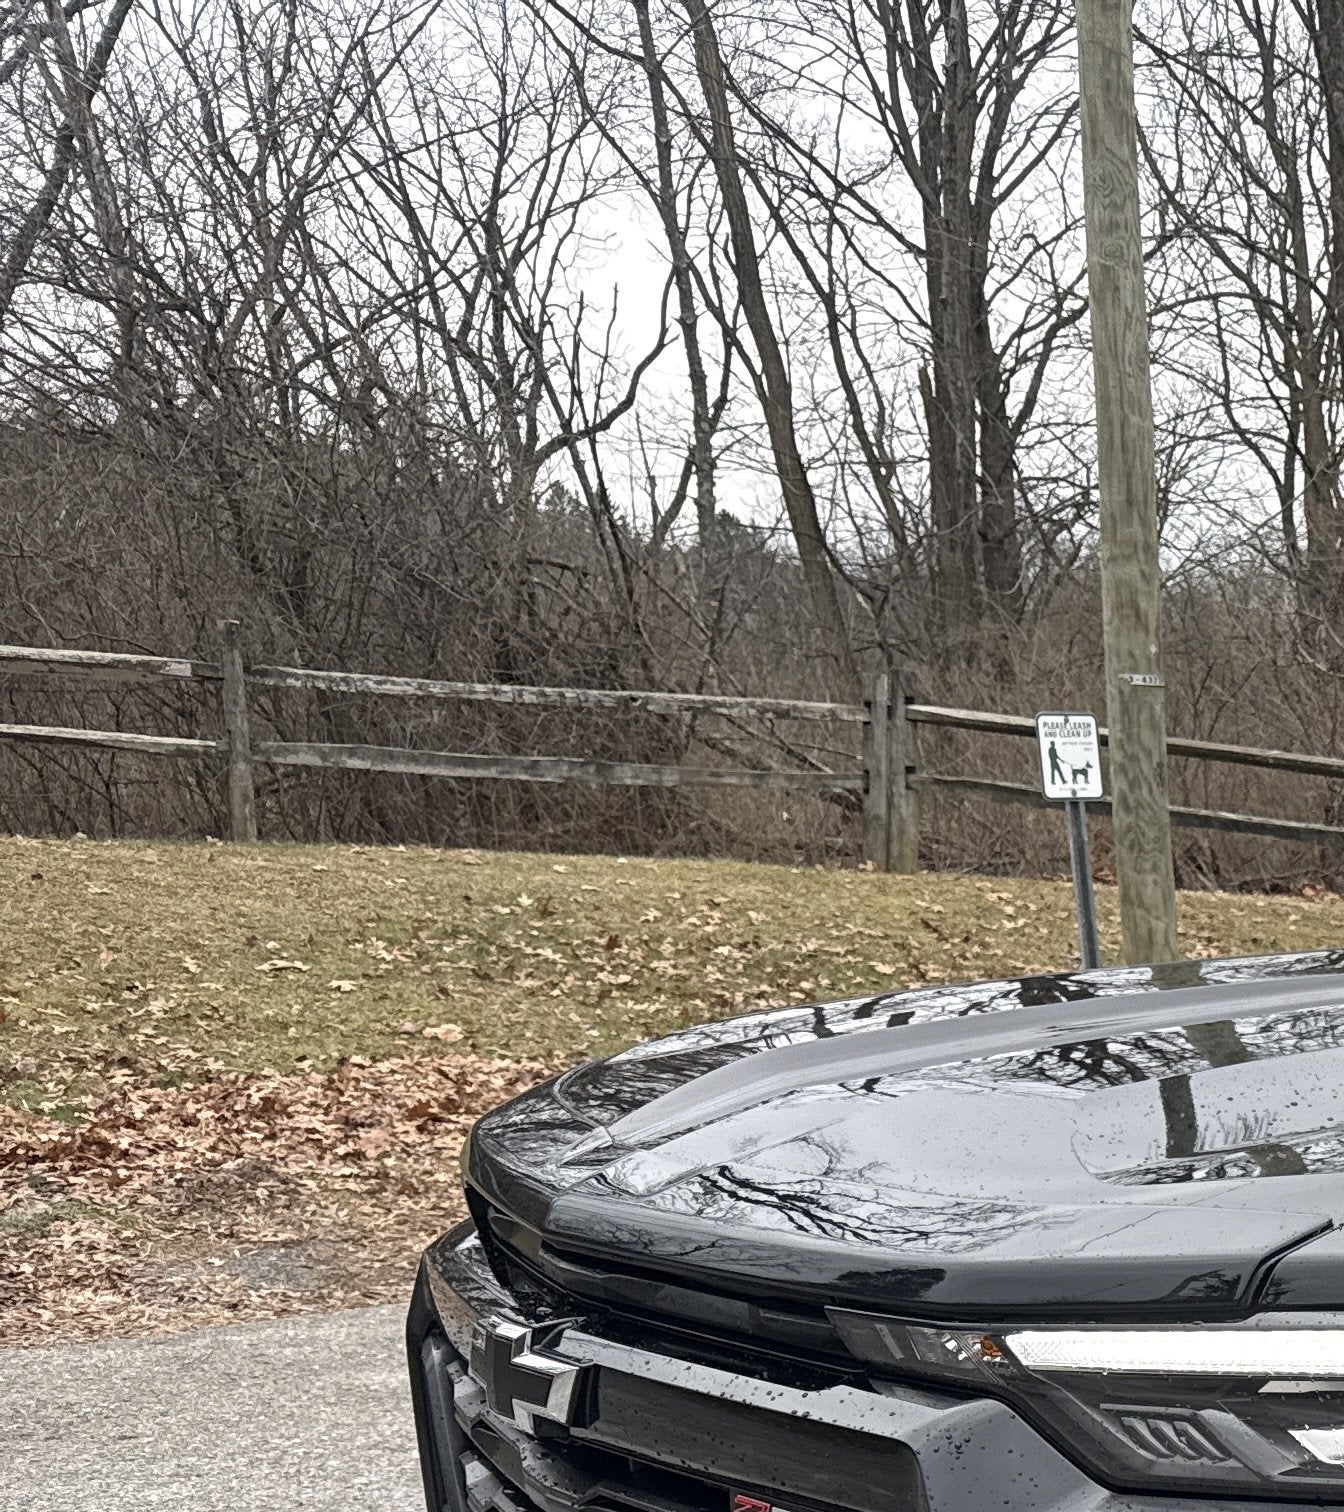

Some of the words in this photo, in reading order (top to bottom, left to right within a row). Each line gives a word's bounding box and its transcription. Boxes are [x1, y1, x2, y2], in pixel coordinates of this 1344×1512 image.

[1042, 721, 1067, 730] PLEASE
[1069, 721, 1091, 730] LEASH
[1044, 730, 1057, 738] AND
[1059, 730, 1081, 738] CLEAN
[1083, 730, 1092, 738] UP
